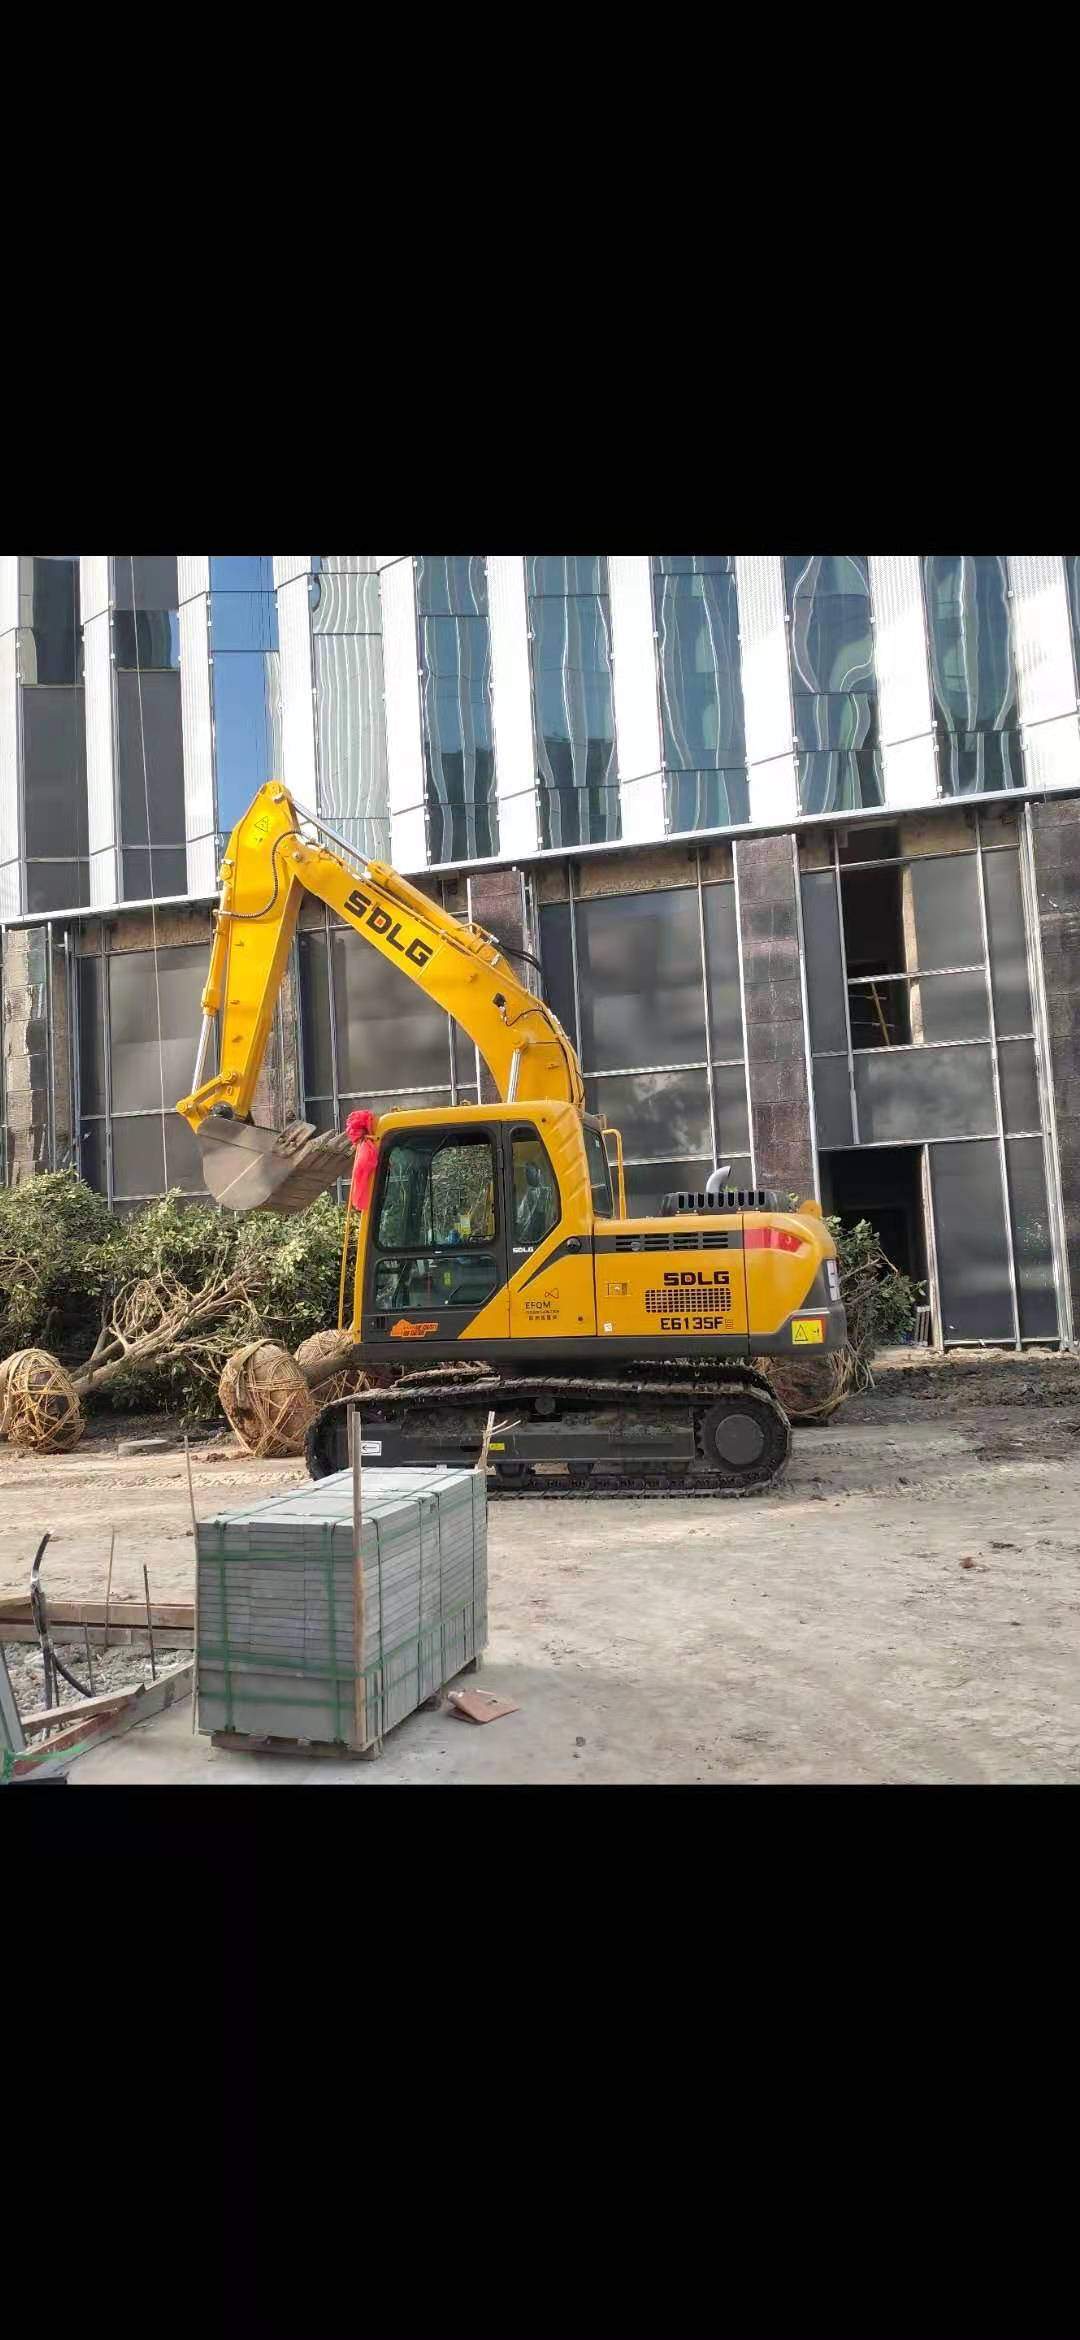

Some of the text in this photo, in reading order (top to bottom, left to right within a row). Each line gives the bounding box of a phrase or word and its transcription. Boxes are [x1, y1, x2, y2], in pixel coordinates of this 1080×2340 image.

[343, 889, 434, 968] SDLG
[663, 1271, 730, 1286] SDLG
[660, 1316, 724, 1330] E6135F
